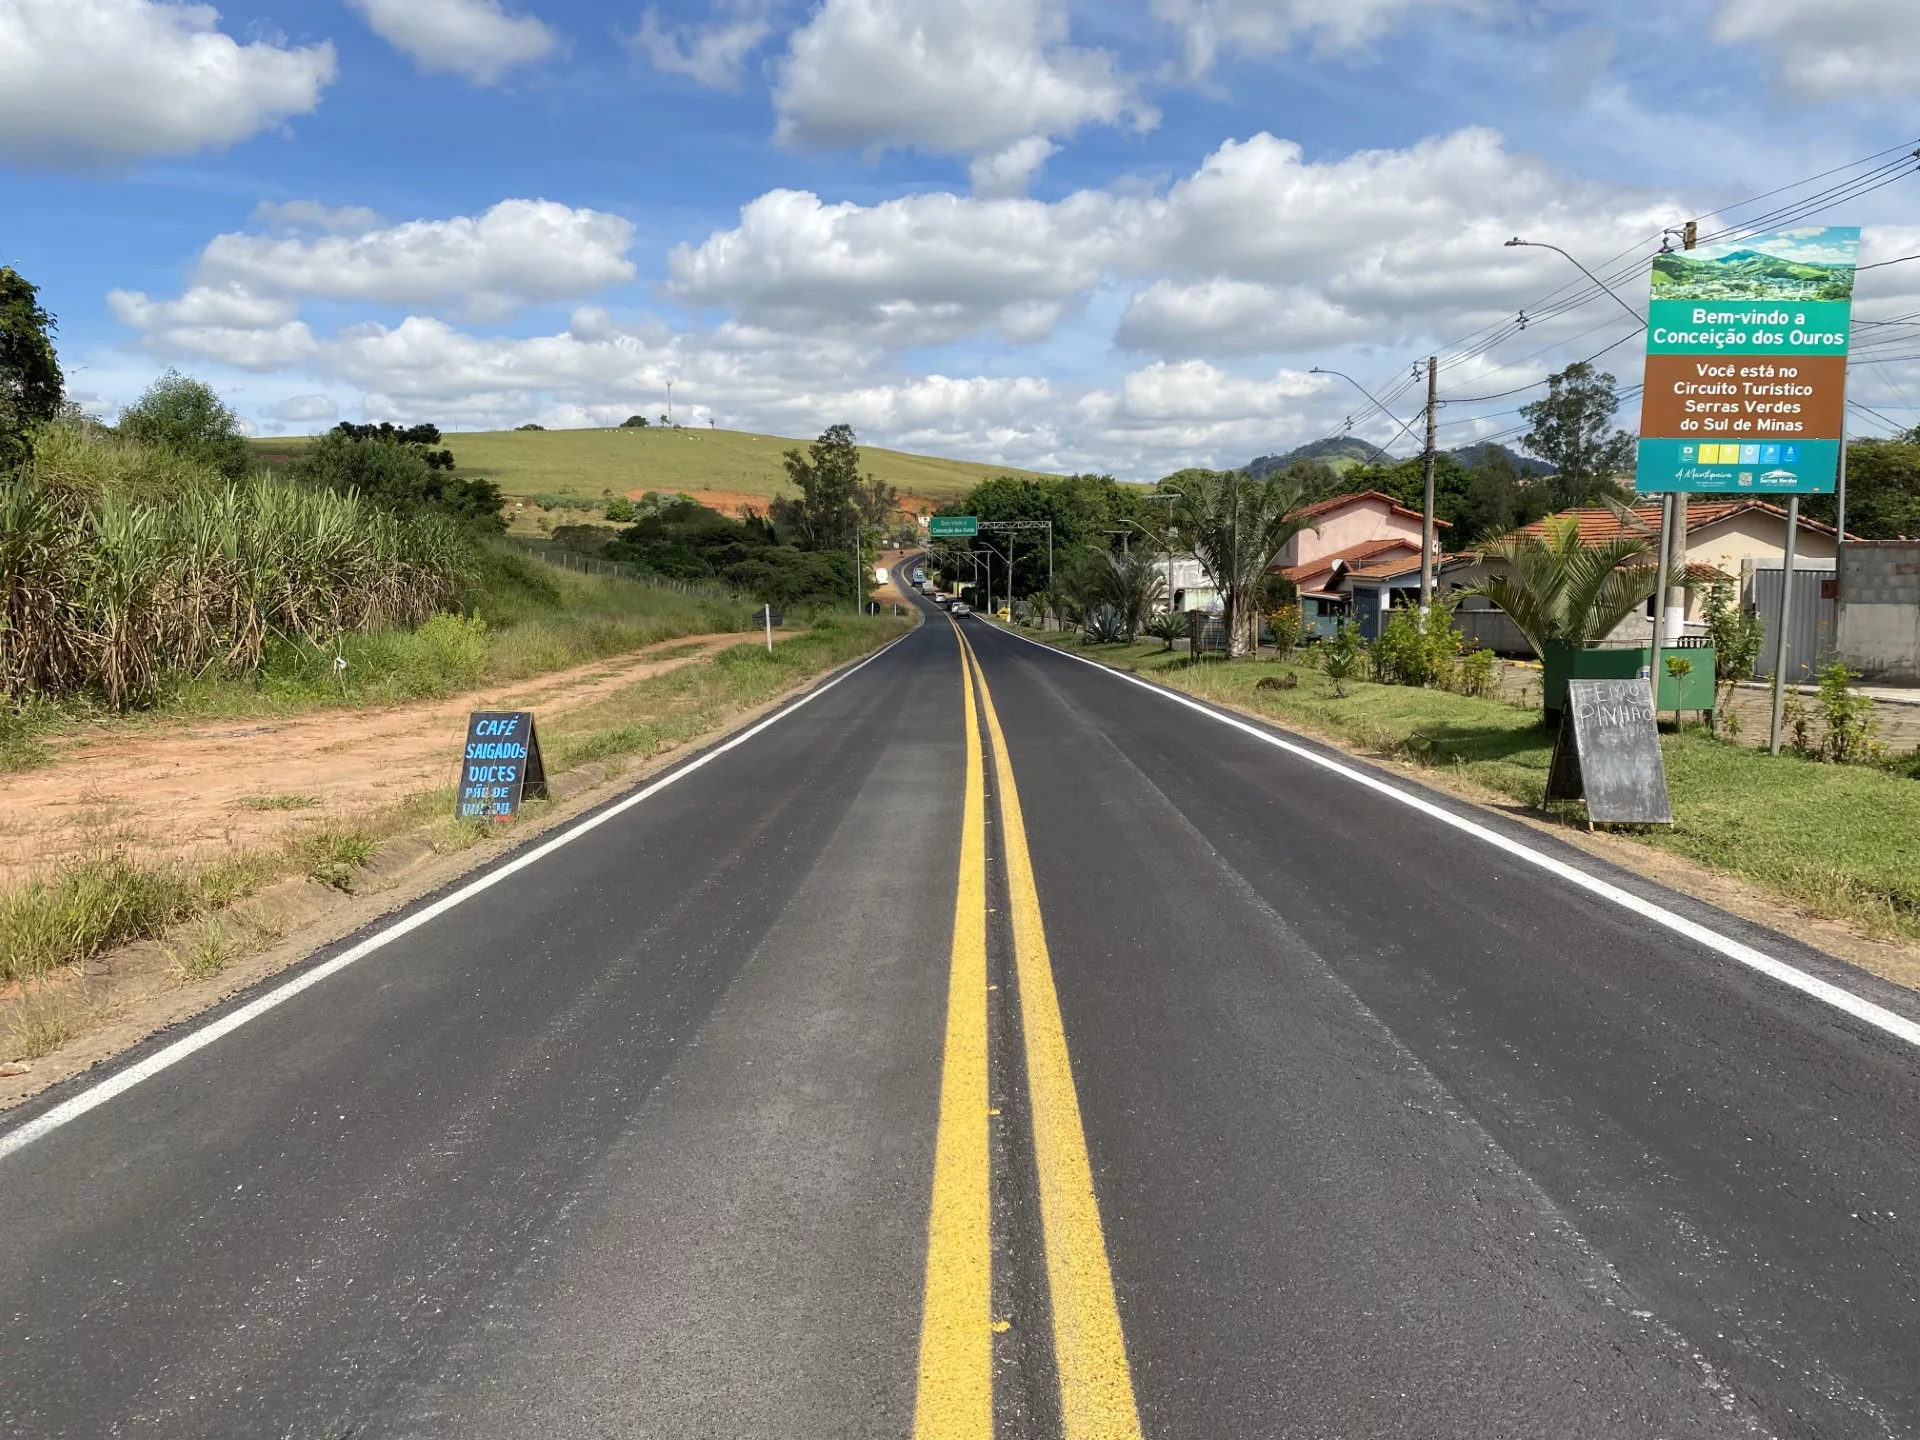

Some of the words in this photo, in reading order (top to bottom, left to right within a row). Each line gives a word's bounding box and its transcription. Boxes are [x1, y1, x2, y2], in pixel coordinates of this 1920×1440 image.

[1692, 308, 1789, 325] Bem-vindo
[1794, 312, 1806, 325] a
[1653, 327, 1747, 349] Conceição
[1752, 329, 1784, 345] dos
[1789, 329, 1845, 346] Ouros
[1696, 363, 1736, 377] Você
[1740, 364, 1775, 378] está
[1779, 367, 1798, 378] no
[1673, 381, 1738, 395] Circuito
[1742, 382, 1813, 396] Turístico
[1685, 399, 1740, 413] Serras
[1744, 400, 1802, 414] Verdes
[1680, 418, 1699, 431] do
[1703, 417, 1729, 431] Sul
[1733, 418, 1752, 431] de
[1757, 418, 1804, 432] Minas
[476, 715, 519, 736] CAFÉ
[469, 765, 516, 782] DOCES
[492, 786, 509, 798] DE
